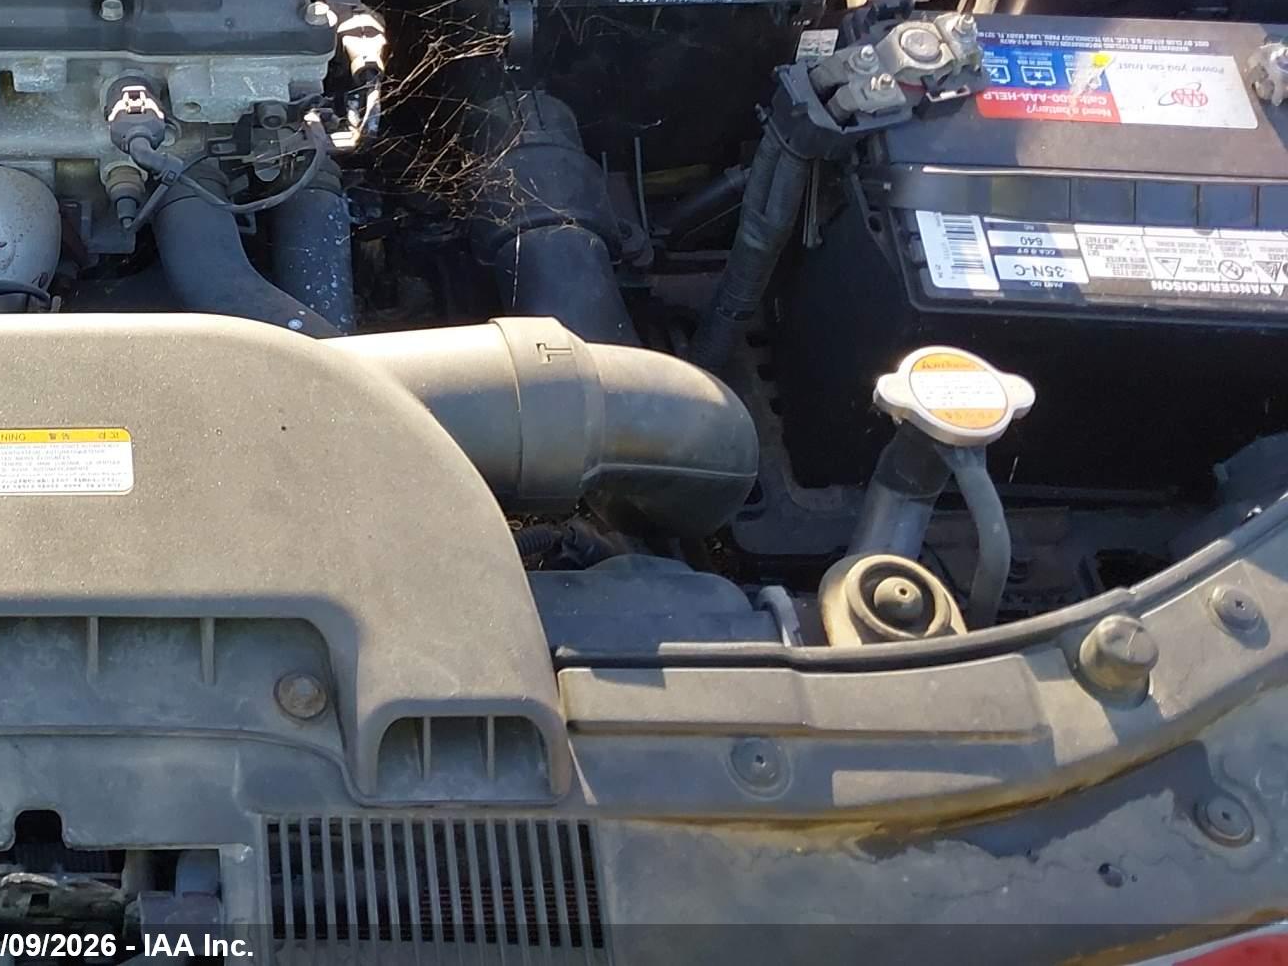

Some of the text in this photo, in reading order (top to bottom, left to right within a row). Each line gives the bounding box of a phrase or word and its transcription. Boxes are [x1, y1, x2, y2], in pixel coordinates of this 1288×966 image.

[1118, 63, 1143, 71] trust
[983, 92, 1075, 104] 00-AAA-HELP
[1019, 236, 1043, 246] 640
[1151, 280, 1271, 295] DANGER/POISON
